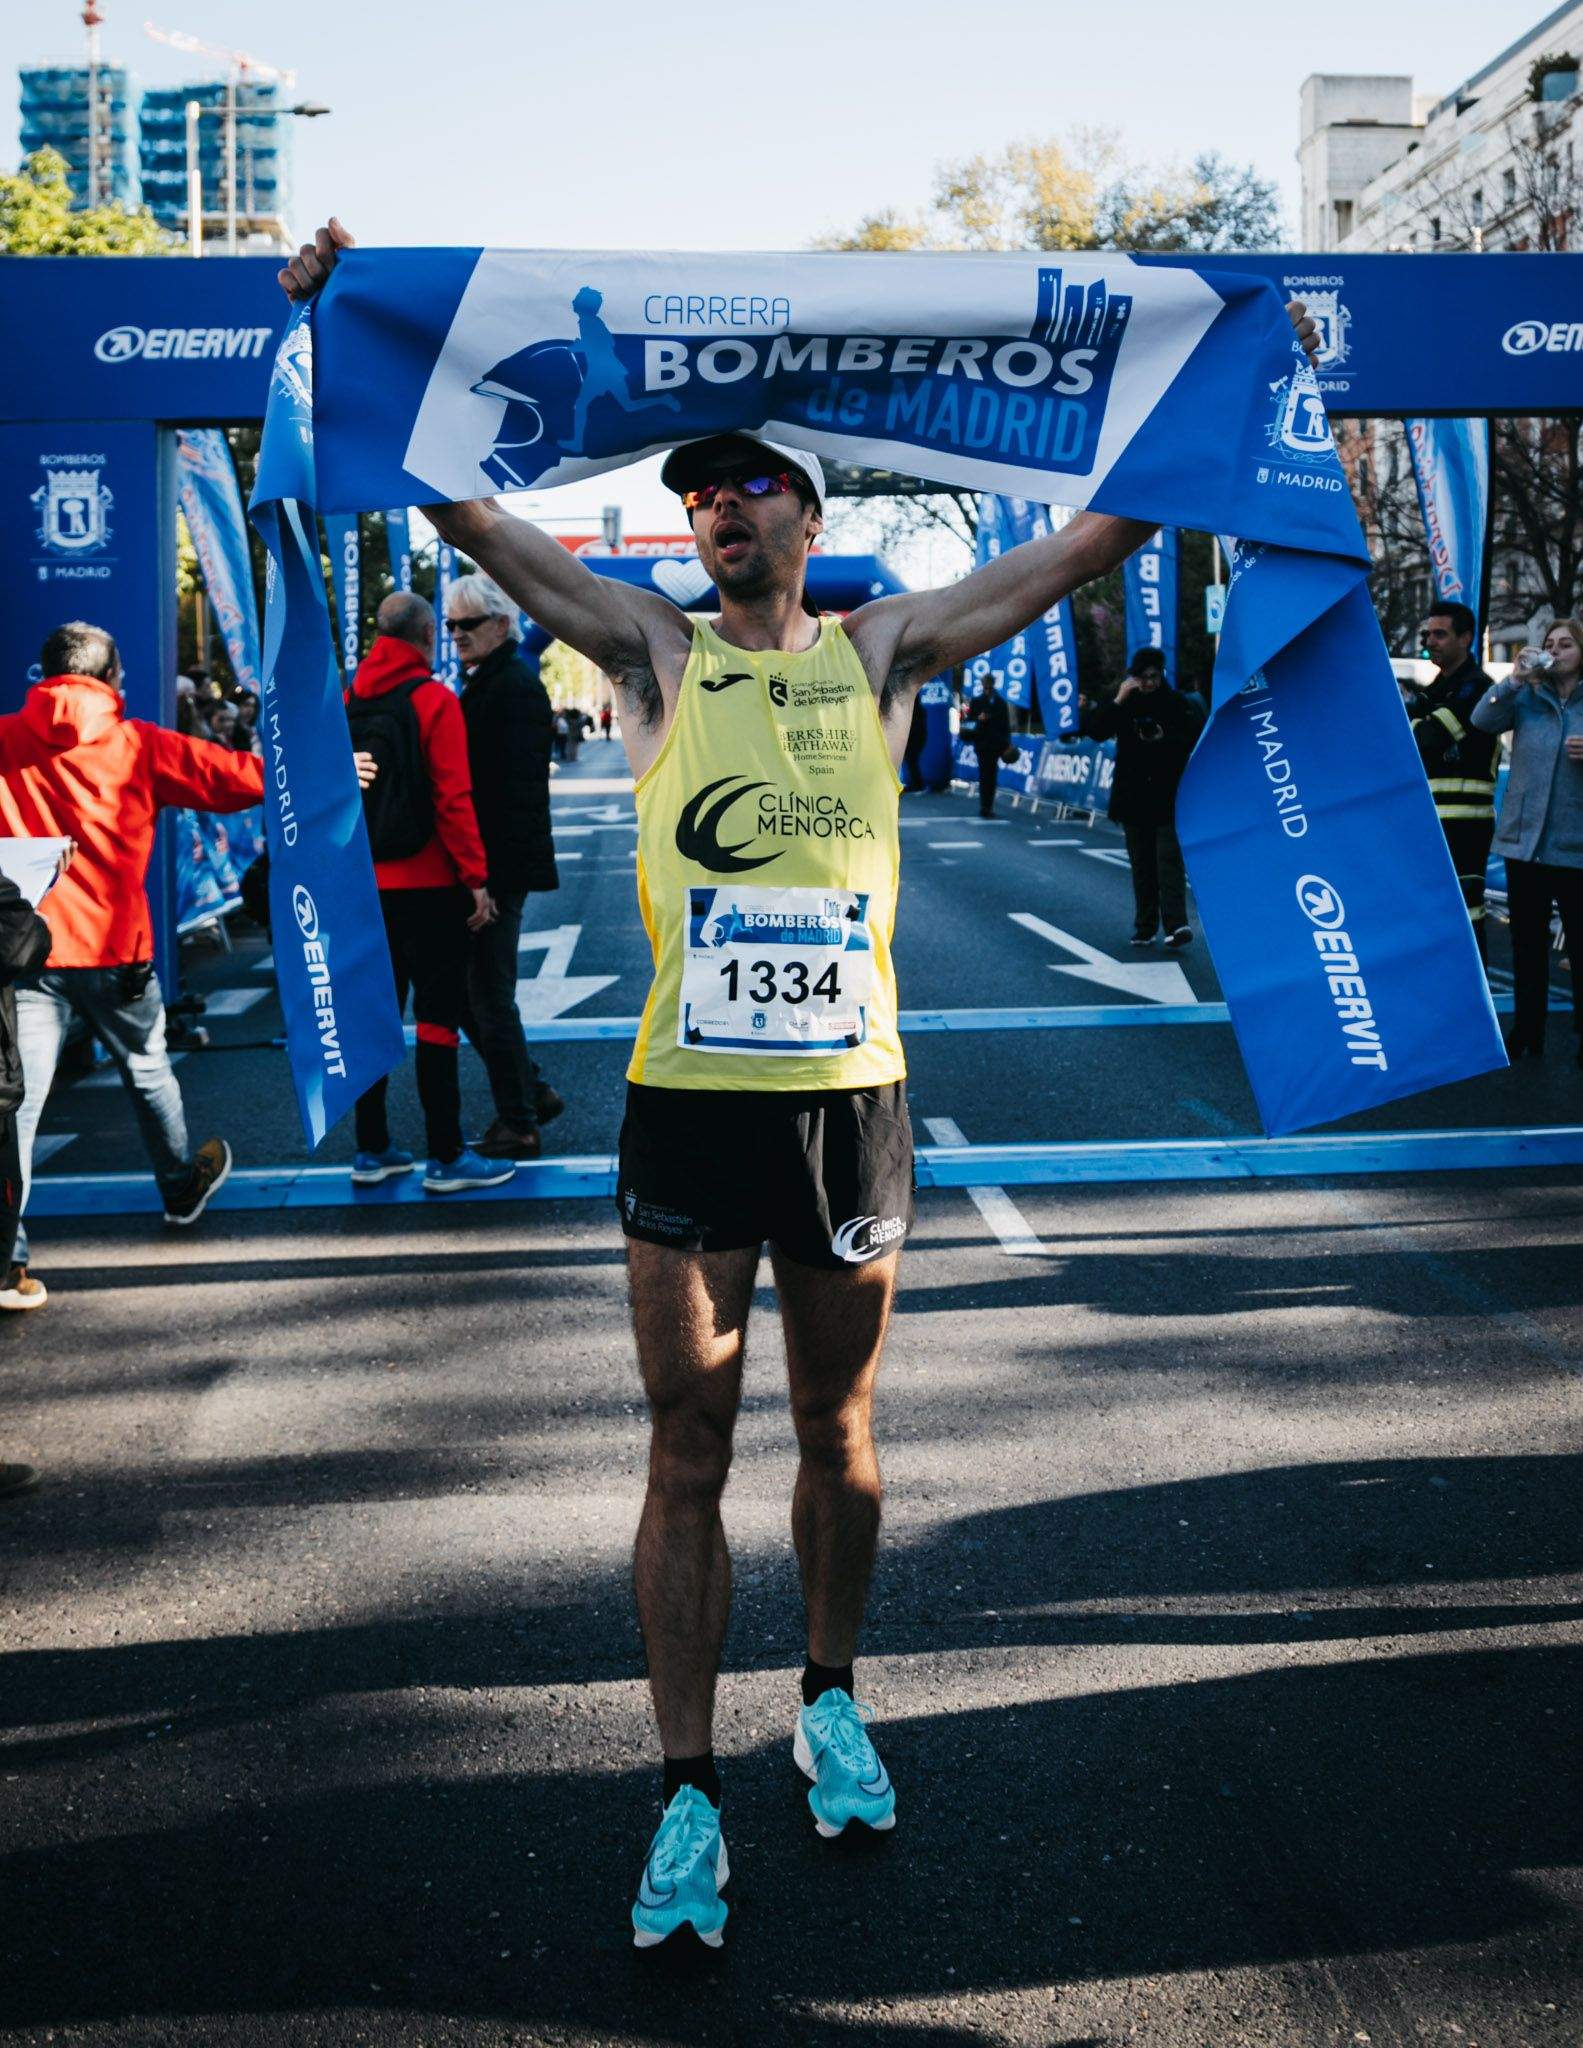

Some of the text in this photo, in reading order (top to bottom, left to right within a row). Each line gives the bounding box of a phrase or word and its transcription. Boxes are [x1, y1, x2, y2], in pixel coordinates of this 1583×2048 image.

[1283, 276, 1345, 287] BOMBEROS
[644, 295, 791, 326] CARRERA
[142, 327, 273, 360] ENERVIT
[645, 337, 1099, 395] BOMBEROS
[1317, 380, 1351, 391] DRID
[806, 377, 1089, 463] de MADRID
[40, 453, 107, 465] BOMBEROS
[1276, 471, 1343, 493] MADRID
[55, 566, 112, 578] MADRID
[783, 740, 855, 752] HATHAWAY
[270, 713, 298, 847] MADRID
[808, 765, 835, 776] Spain
[1250, 709, 1308, 839] MADRID
[758, 790, 849, 815] CLÍNICA
[757, 814, 876, 840] MENORCA
[744, 913, 840, 929] BOMBEROS
[781, 928, 840, 943] de MADRID
[720, 959, 842, 1005] 1334
[303, 940, 347, 1079] ENERVIT
[1312, 929, 1389, 1072] ENERVIT
